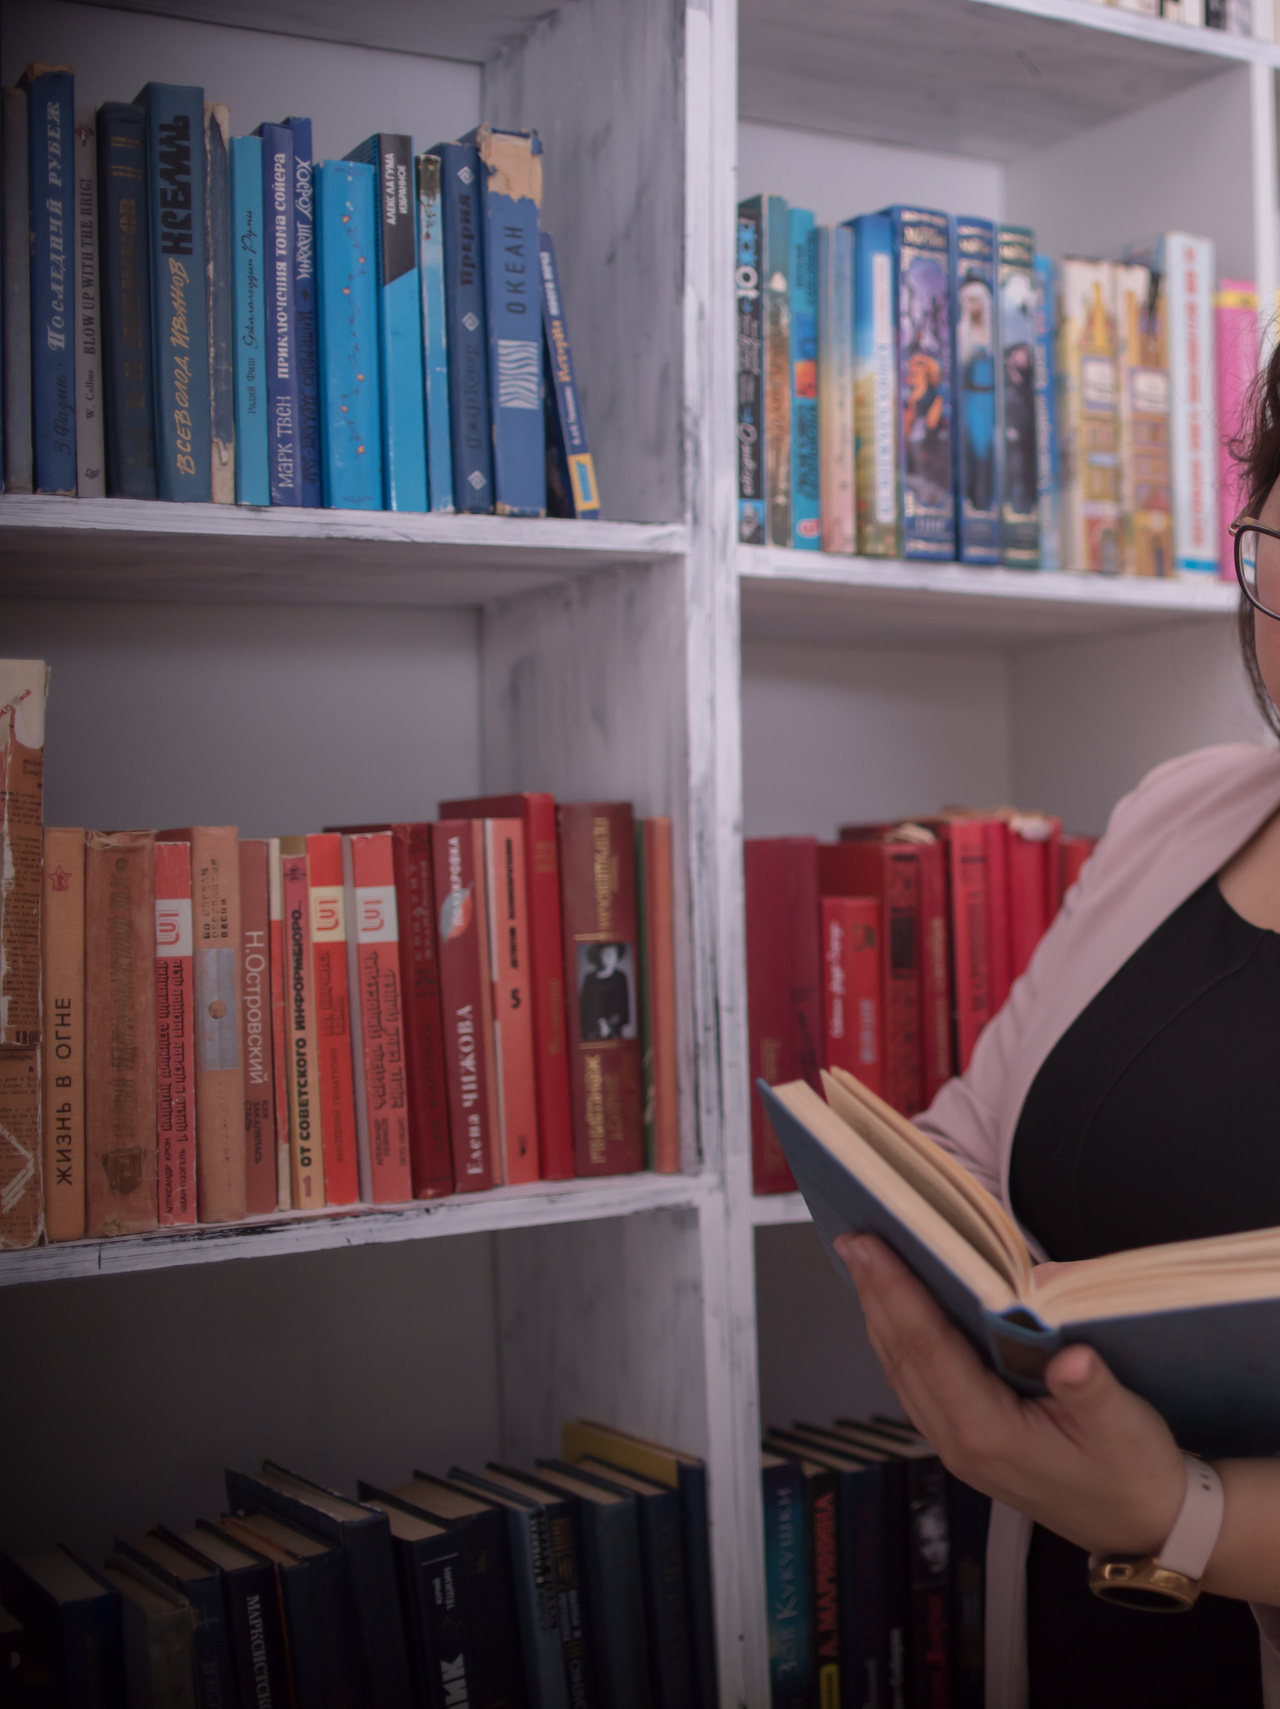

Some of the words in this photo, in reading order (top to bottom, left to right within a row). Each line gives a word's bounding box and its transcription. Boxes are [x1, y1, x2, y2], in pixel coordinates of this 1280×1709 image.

[46, 99, 64, 185] РУБЕЖ
[383, 152, 396, 180] ГУМА
[79, 177, 95, 217] BRIG!
[158, 113, 194, 256] КРЕМЛЬ
[293, 156, 313, 222] ХОСРОУ
[384, 180, 396, 195] ЛА
[396, 164, 408, 215] ИЗБРАННОЕ
[80, 219, 95, 249] THE
[240, 209, 258, 255] Руми
[385, 195, 398, 226] АЛЕКС
[81, 251, 96, 290] WITH
[502, 225, 529, 316] ОКЕАН
[82, 291, 96, 311] UP
[167, 255, 190, 349] ИВАНОВ
[82, 313, 97, 355] BLOW
[84, 368, 96, 402] Collins
[244, 357, 256, 382] Фиш
[175, 356, 197, 475] ВСЕВОЛОД
[246, 385, 257, 415] Радий
[55, 998, 73, 1061] ОГНЕ
[242, 929, 269, 1085] Н.Островский
[172, 1041, 187, 1084] ПЕРВОЕ
[424, 1021, 440, 1109] КАССИЛЬ
[456, 1003, 480, 1108] ЧИЖОВА
[56, 1074, 73, 1089] В
[295, 1037, 313, 1142] СОВЕТСКОГО
[158, 1082, 173, 1132] КАПИТАН
[261, 1099, 270, 1120] КАК
[54, 1101, 74, 1187] ЖИЗНЬ
[162, 1137, 173, 1162] КРОН
[300, 1145, 314, 1169] ОТ
[464, 1112, 486, 1176] Елена
[163, 1164, 174, 1214] АЛЕКСАНДР
[439, 1653, 471, 1709] ИК
